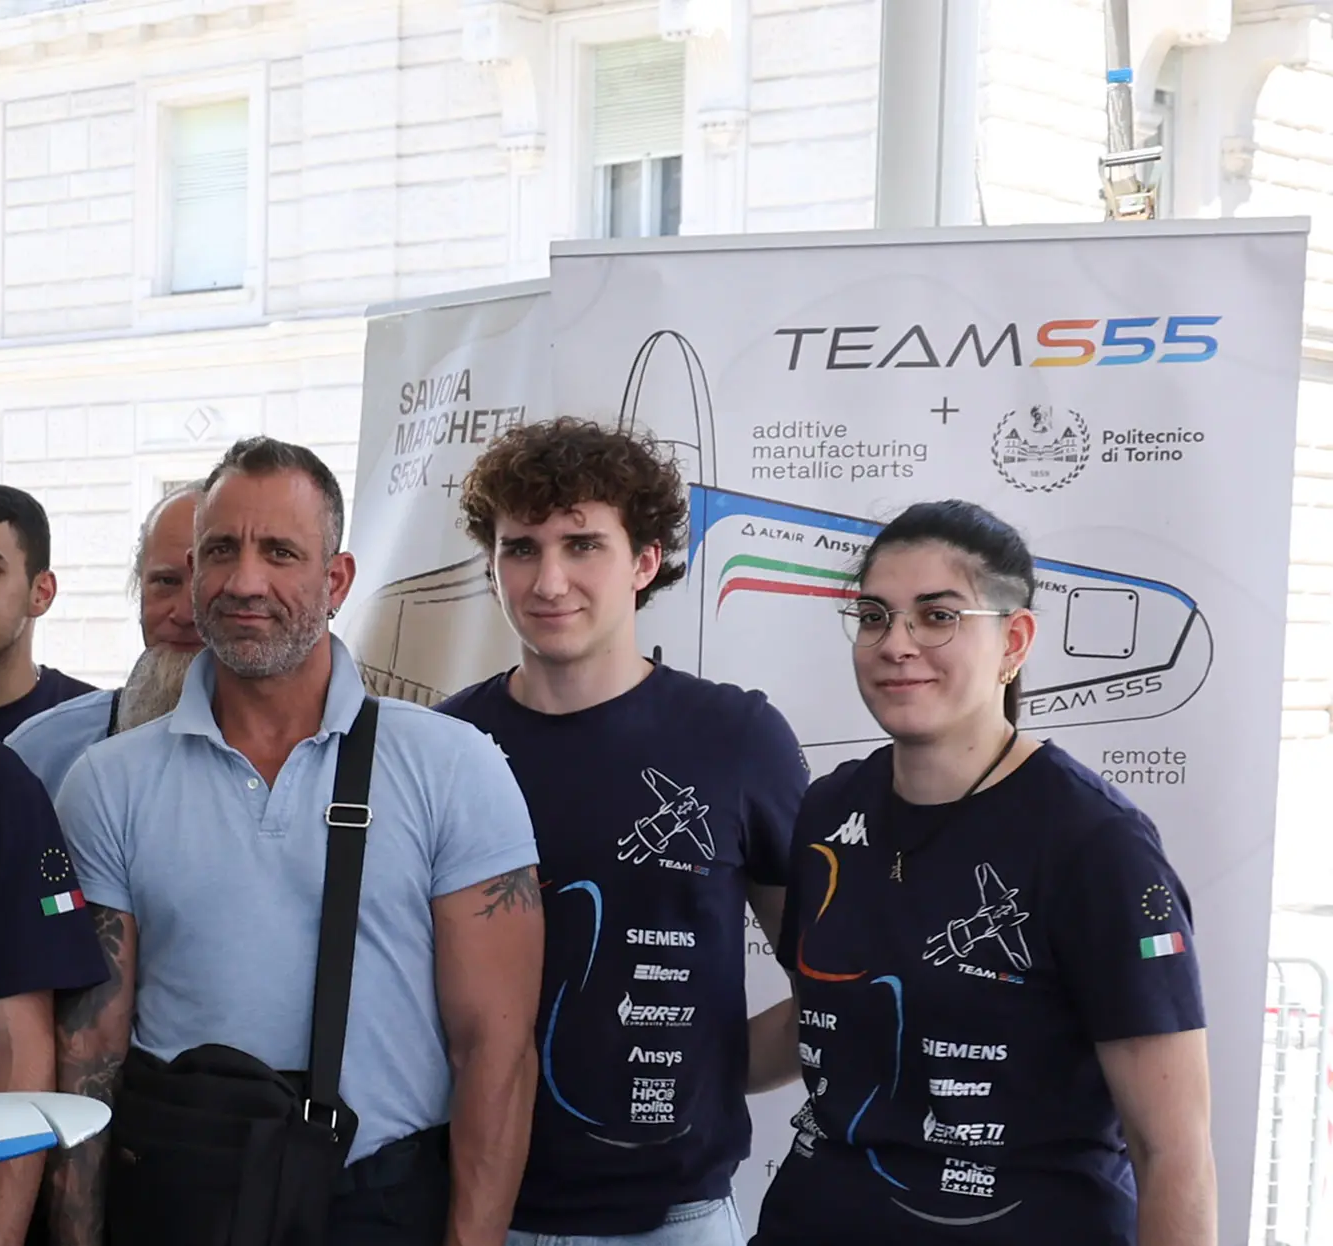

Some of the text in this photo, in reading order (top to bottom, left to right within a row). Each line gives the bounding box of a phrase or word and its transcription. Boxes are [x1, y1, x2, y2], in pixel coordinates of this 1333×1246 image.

[399, 368, 471, 415] SAVOIA
[752, 420, 847, 440] additive
[1102, 427, 1205, 445] Politecnico
[752, 440, 928, 462] manufacturing
[1101, 446, 1183, 463] di Torino
[751, 461, 914, 483] metallic parts
[759, 527, 870, 557] ALTAIR Ansys
[1033, 579, 1068, 594] MENS
[1106, 675, 1162, 702] S55
[1102, 747, 1187, 765] remote
[1100, 767, 1186, 785] control
[658, 858, 692, 872] TEAM
[626, 928, 696, 947] SIEMENS
[633, 964, 690, 982] Ellena
[958, 963, 997, 979] TEAM
[628, 1046, 682, 1067] Ansys
[922, 1038, 1008, 1061] SIEMENS
[632, 1087, 675, 1101] HPC@
[929, 1079, 992, 1097] Ellena
[631, 1101, 674, 1114] polito
[941, 1168, 995, 1186] polito
